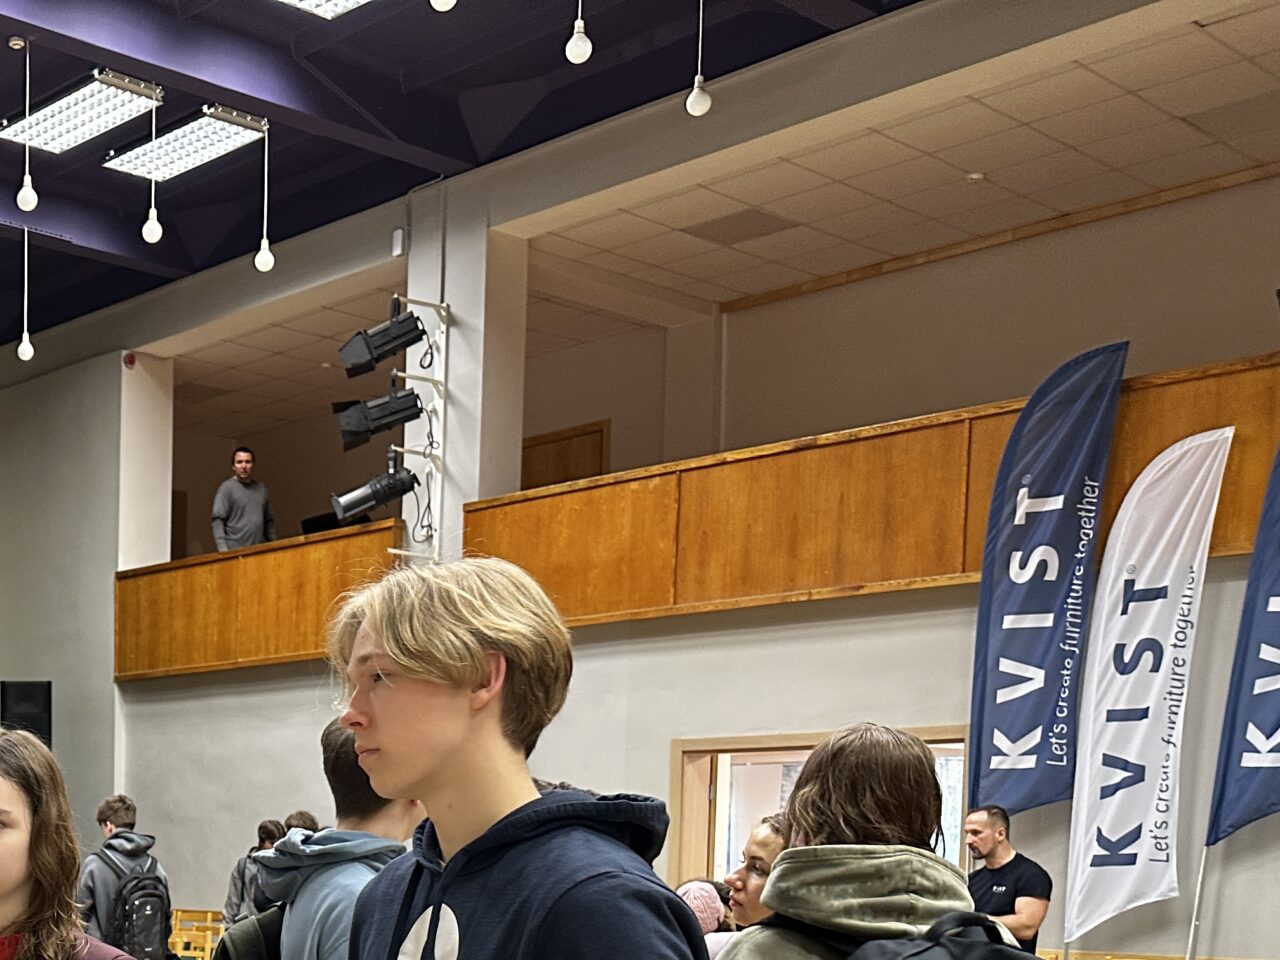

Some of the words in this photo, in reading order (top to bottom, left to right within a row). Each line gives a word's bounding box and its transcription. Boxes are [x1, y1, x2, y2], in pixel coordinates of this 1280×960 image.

[1074, 476, 1100, 559] together
[990, 487, 1065, 769] KVIST
[1060, 565, 1084, 655] furniture
[1056, 658, 1074, 717] create
[1090, 579, 1169, 868] KVIST
[1046, 723, 1067, 766] Let's
[1149, 820, 1170, 864] Let's
